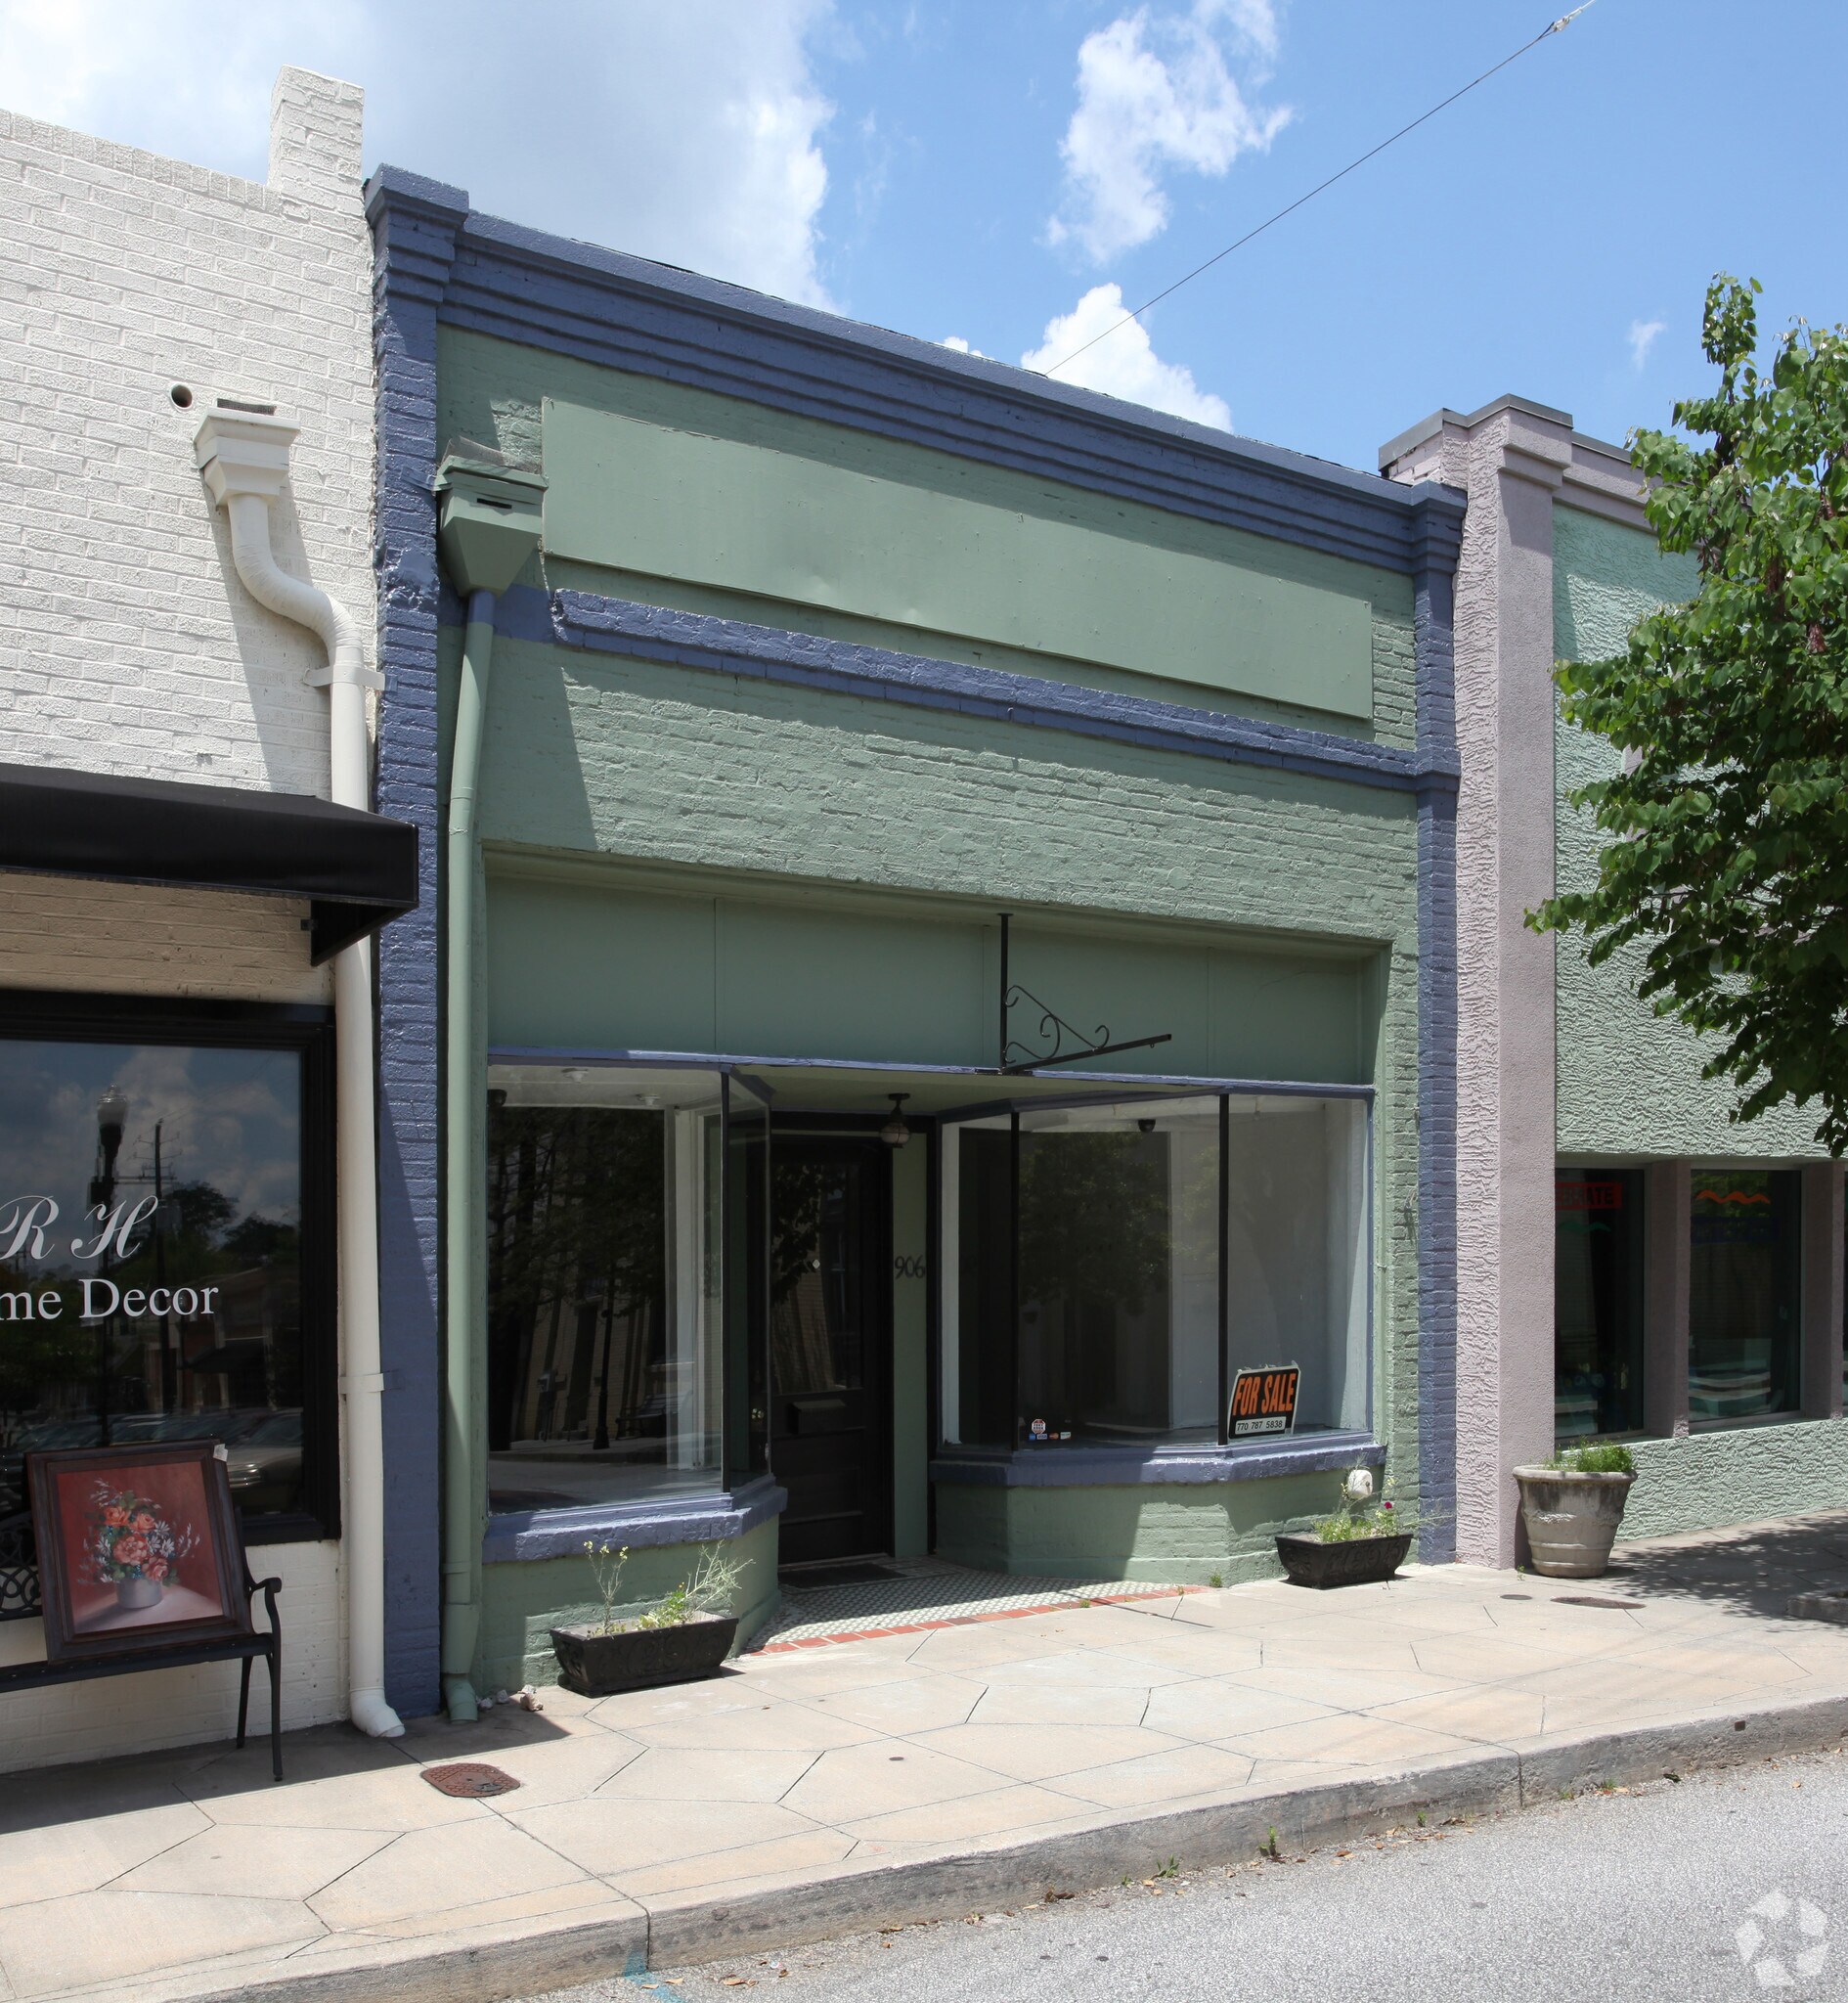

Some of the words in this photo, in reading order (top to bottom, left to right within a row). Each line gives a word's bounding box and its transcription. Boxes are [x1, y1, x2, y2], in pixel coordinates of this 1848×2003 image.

[894, 1255, 925, 1279] 906
[78, 1278, 219, 1318] Decor
[1232, 1376, 1261, 1416] FOR
[1261, 1372, 1297, 1414] SALE
[1236, 1422, 1249, 1431] 770
[1252, 1420, 1262, 1430] 787
